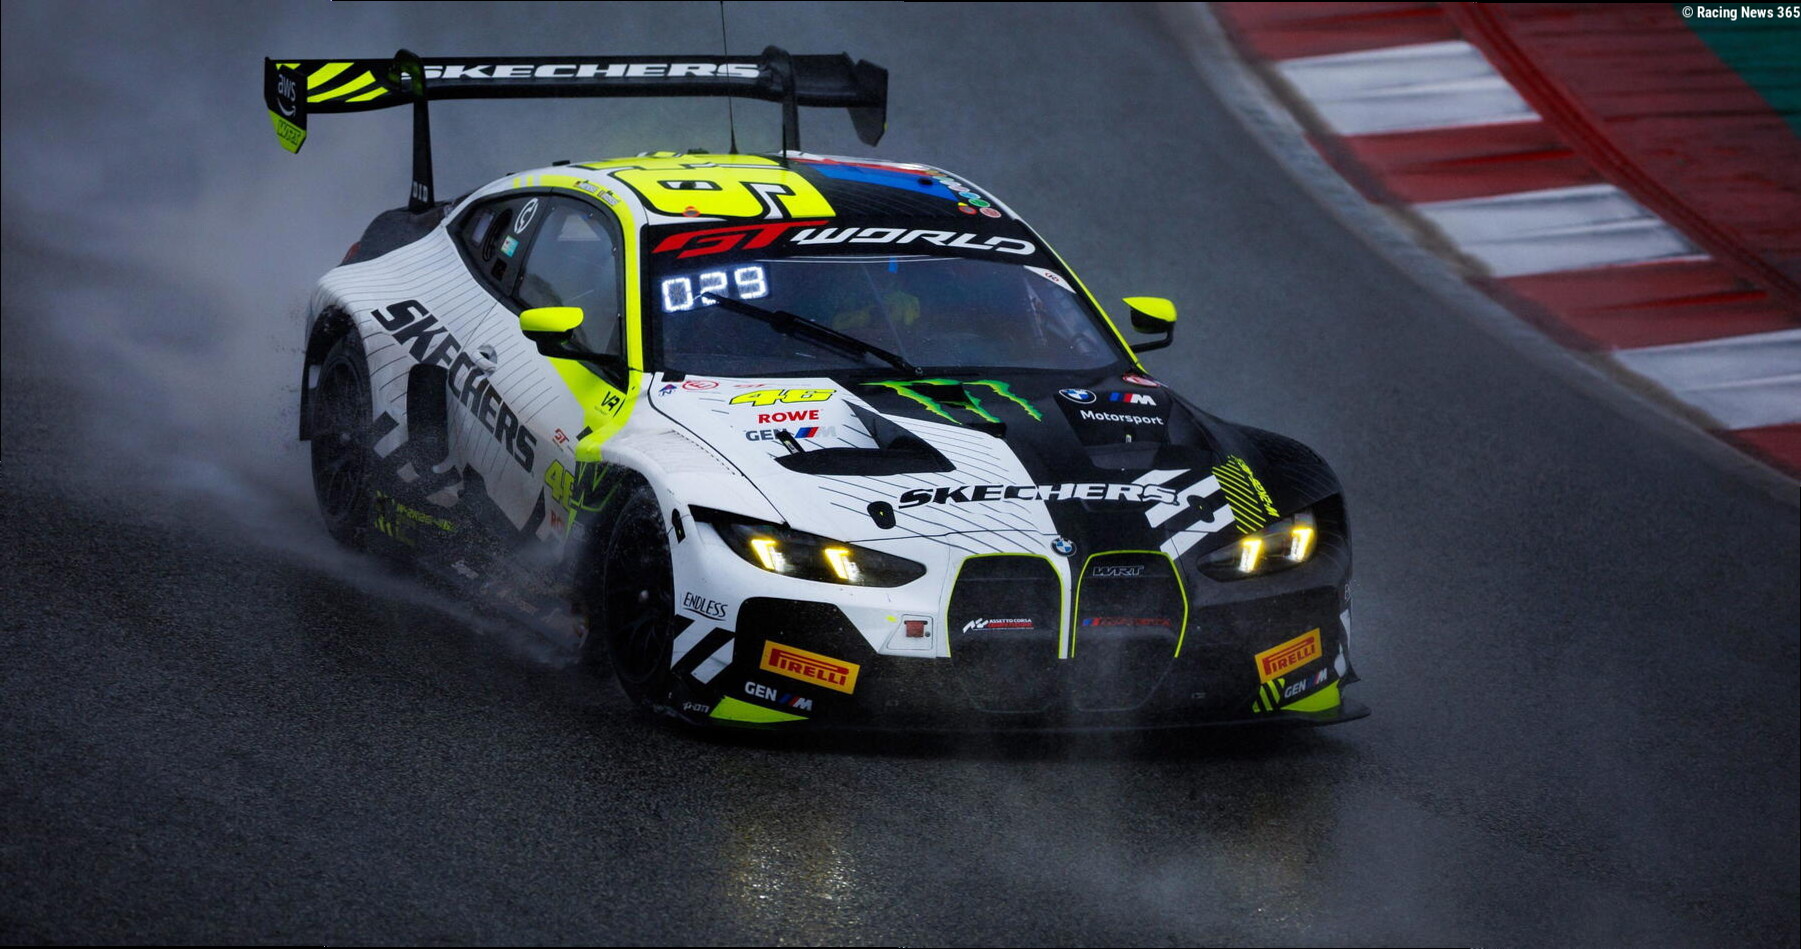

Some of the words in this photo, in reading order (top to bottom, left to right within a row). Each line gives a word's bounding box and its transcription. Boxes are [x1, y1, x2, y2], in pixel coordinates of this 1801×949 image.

[401, 63, 760, 80] SKECHERS
[277, 73, 297, 102] aws
[651, 220, 831, 259] GT
[789, 227, 1036, 256] WORLD
[662, 266, 768, 313] 029
[371, 300, 538, 474] SKECHERS
[729, 388, 838, 407] 46
[758, 408, 820, 424] ROWE
[1080, 409, 1165, 426] Motorsport
[899, 482, 1176, 509] SKECHERS
[1092, 565, 1145, 577] WRT
[683, 592, 729, 618] ENDLESS
[768, 648, 849, 687] PIRELLI
[1261, 636, 1315, 676] PIRELLI
[744, 681, 778, 702] GEN
[1284, 678, 1307, 698] GEN
